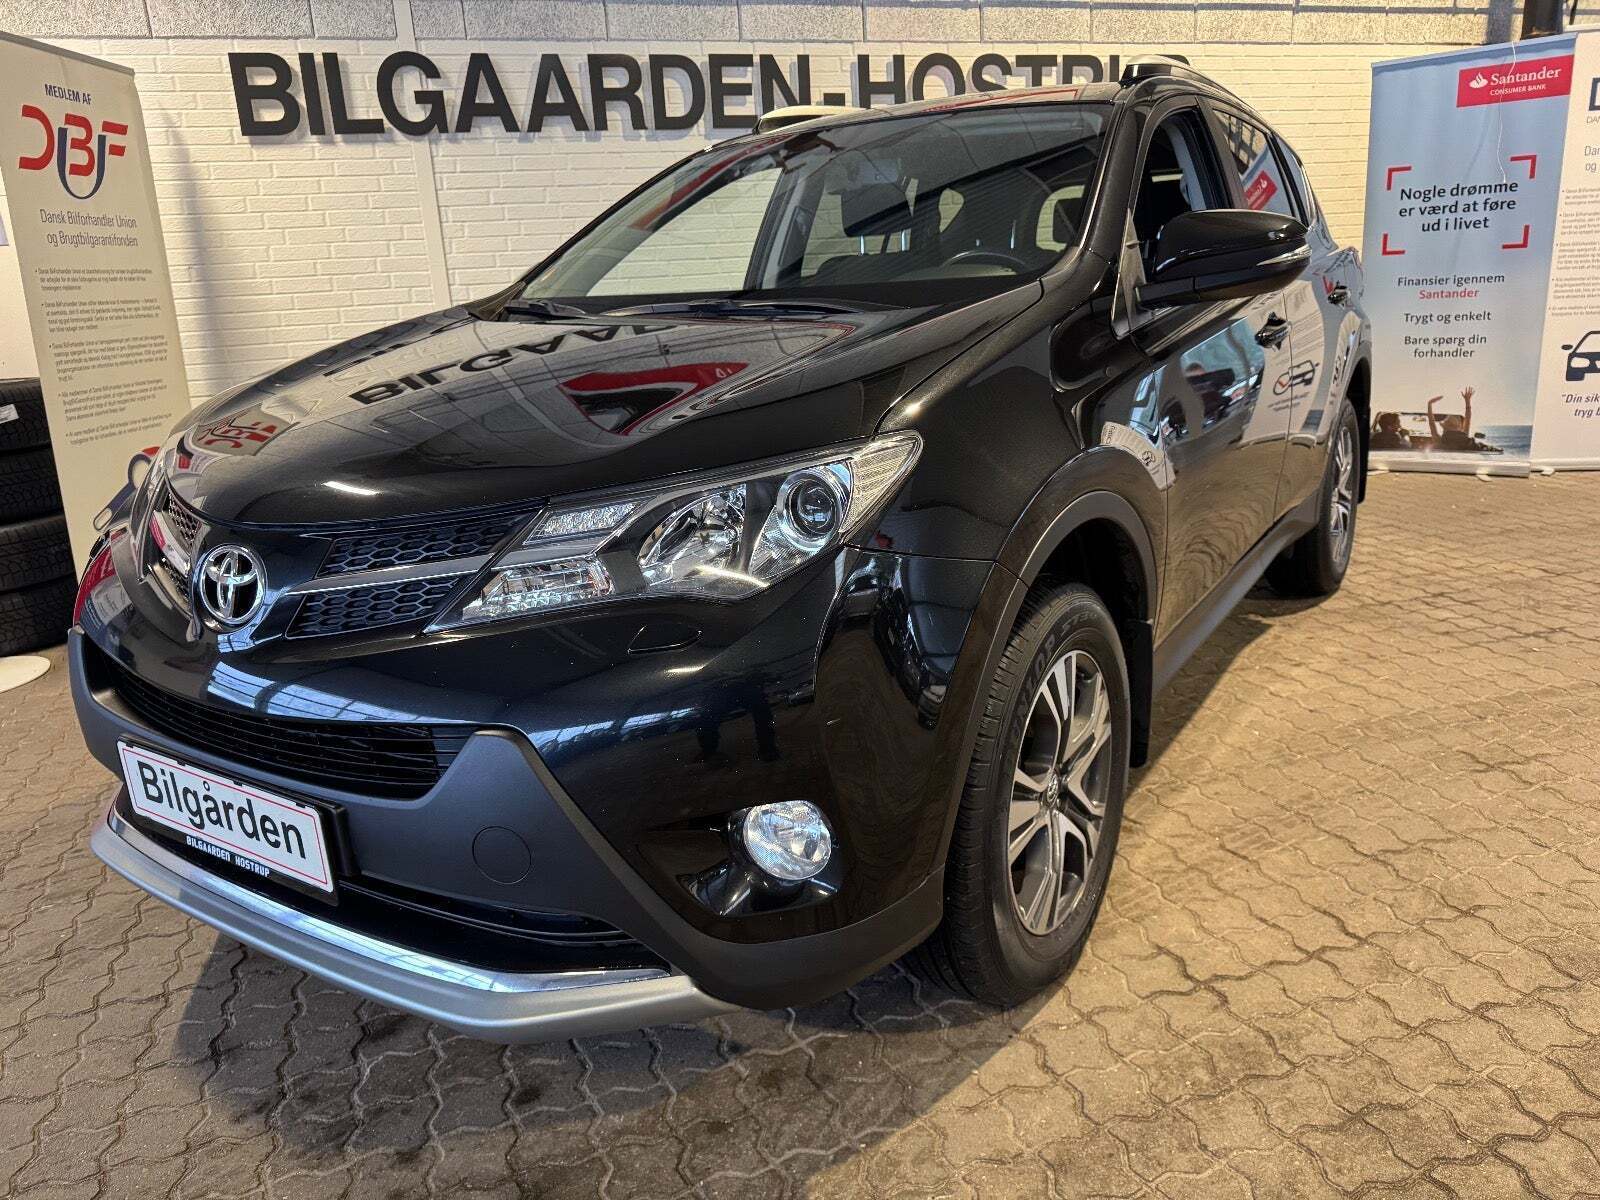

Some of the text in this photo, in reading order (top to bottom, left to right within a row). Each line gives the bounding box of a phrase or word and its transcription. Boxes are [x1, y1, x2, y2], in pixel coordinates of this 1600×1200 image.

[1489, 66, 1562, 86] Santander
[44, 83, 92, 105] MEDLEM AF
[228, 51, 1189, 137] BILGAARDEN-HOST
[1490, 83, 1546, 96] CONSUMER BANK
[1400, 181, 1519, 202] Nogle drømme
[1399, 197, 1517, 217] er værd at føre
[40, 208, 66, 223] Dansk
[116, 214, 138, 228] Union
[1421, 215, 1490, 232] ud i livet
[47, 233, 58, 246] og
[1397, 273, 1506, 287] Finansier igennem
[1419, 288, 1480, 300] Santander
[1404, 310, 1492, 324] Trygt og enkelt
[1404, 333, 1488, 347] Bare spørg din
[1413, 348, 1475, 358] forhandler
[136, 759, 307, 860] Bilgården
[186, 835, 270, 878] BILGAARDEN HOSTRUP
